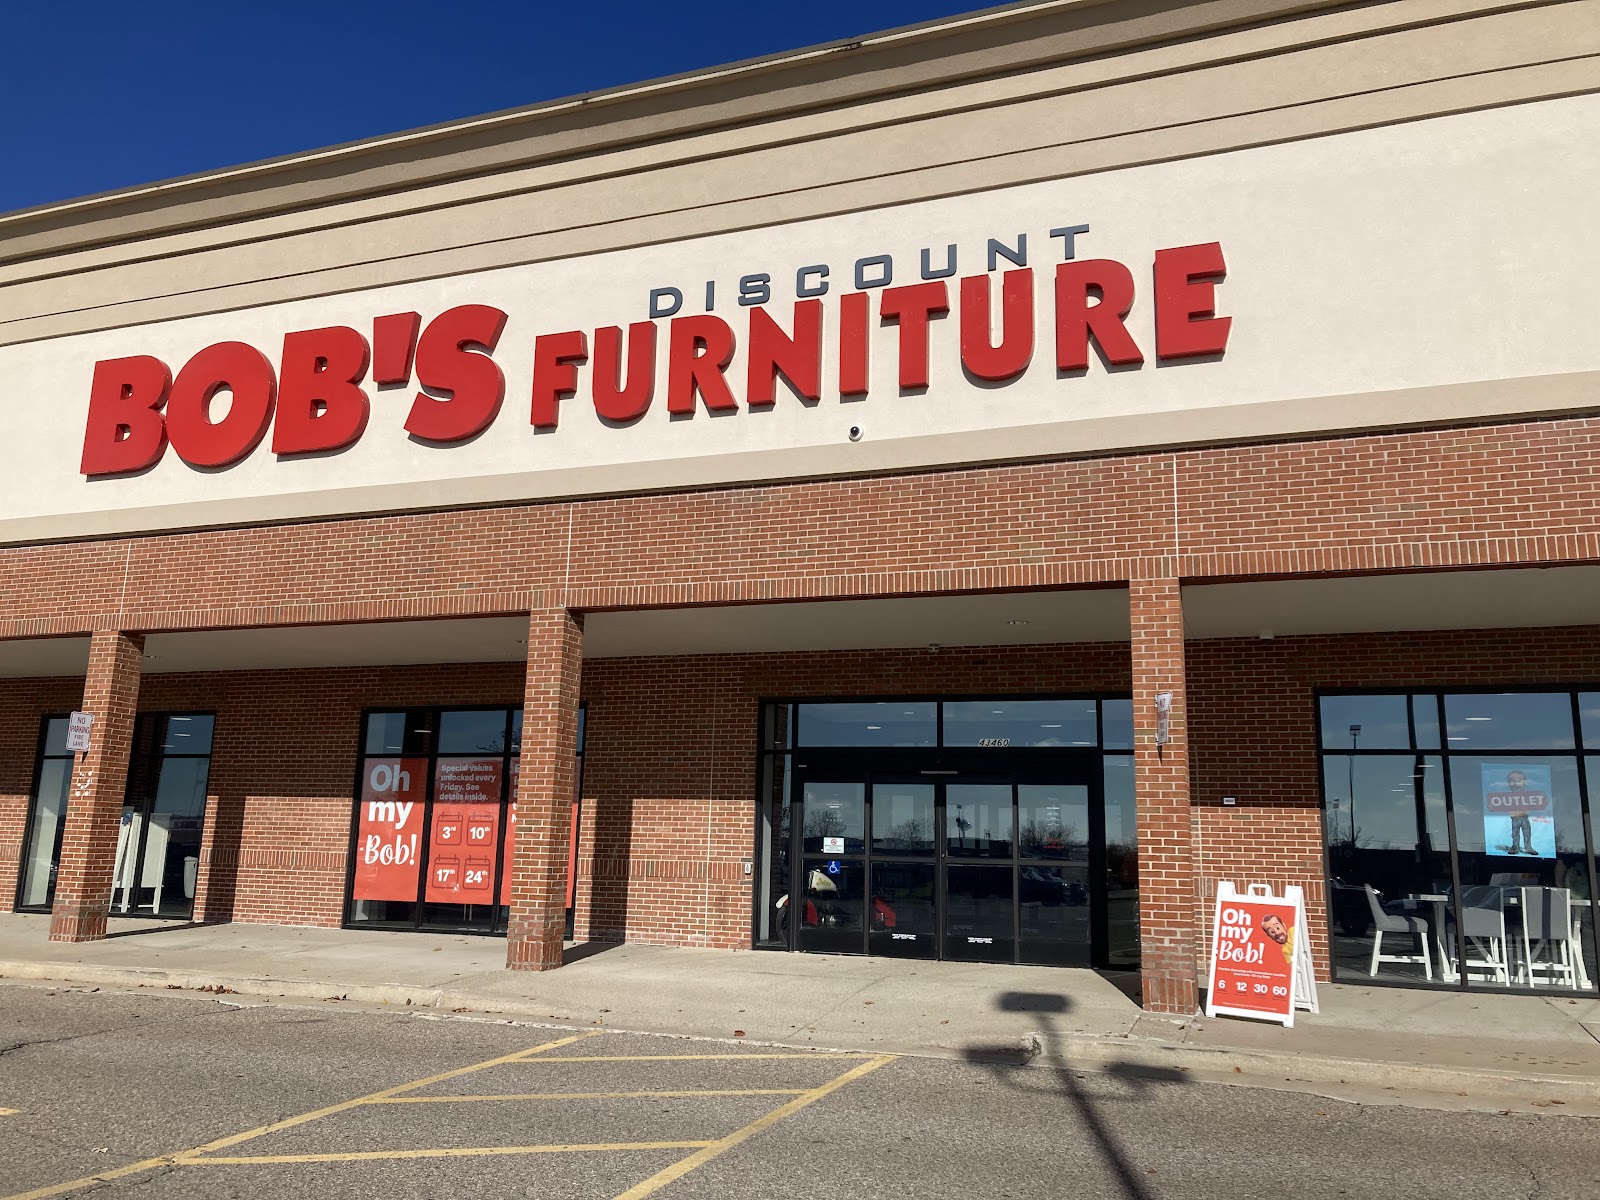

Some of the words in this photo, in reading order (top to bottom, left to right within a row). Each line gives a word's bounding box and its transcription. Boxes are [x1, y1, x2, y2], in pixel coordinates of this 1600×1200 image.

[649, 224, 1090, 319] DISCOUNT
[80, 304, 508, 475] BOB'S
[530, 241, 1233, 428] FURNITURE
[77, 716, 86, 725] NO
[70, 725, 90, 734] PARKING
[979, 739, 1010, 747] 43460
[441, 764, 468, 773] Special
[469, 764, 493, 772] values
[370, 764, 411, 792] Oh
[440, 773, 474, 781] unlocked
[475, 774, 496, 783] every
[440, 783, 464, 792] Friday.
[465, 783, 480, 791] See
[439, 793, 464, 801] details
[465, 793, 489, 801] inside.
[1491, 795, 1545, 807] OUTLET
[368, 801, 414, 830] my
[364, 833, 417, 866] Bob!
[1222, 908, 1252, 926] Oh
[1221, 926, 1254, 943] my
[1219, 940, 1265, 965] Bob!
[1218, 979, 1226, 989] 6
[1236, 981, 1248, 991] 12
[1253, 983, 1268, 994] 30
[1272, 985, 1287, 996] 60
